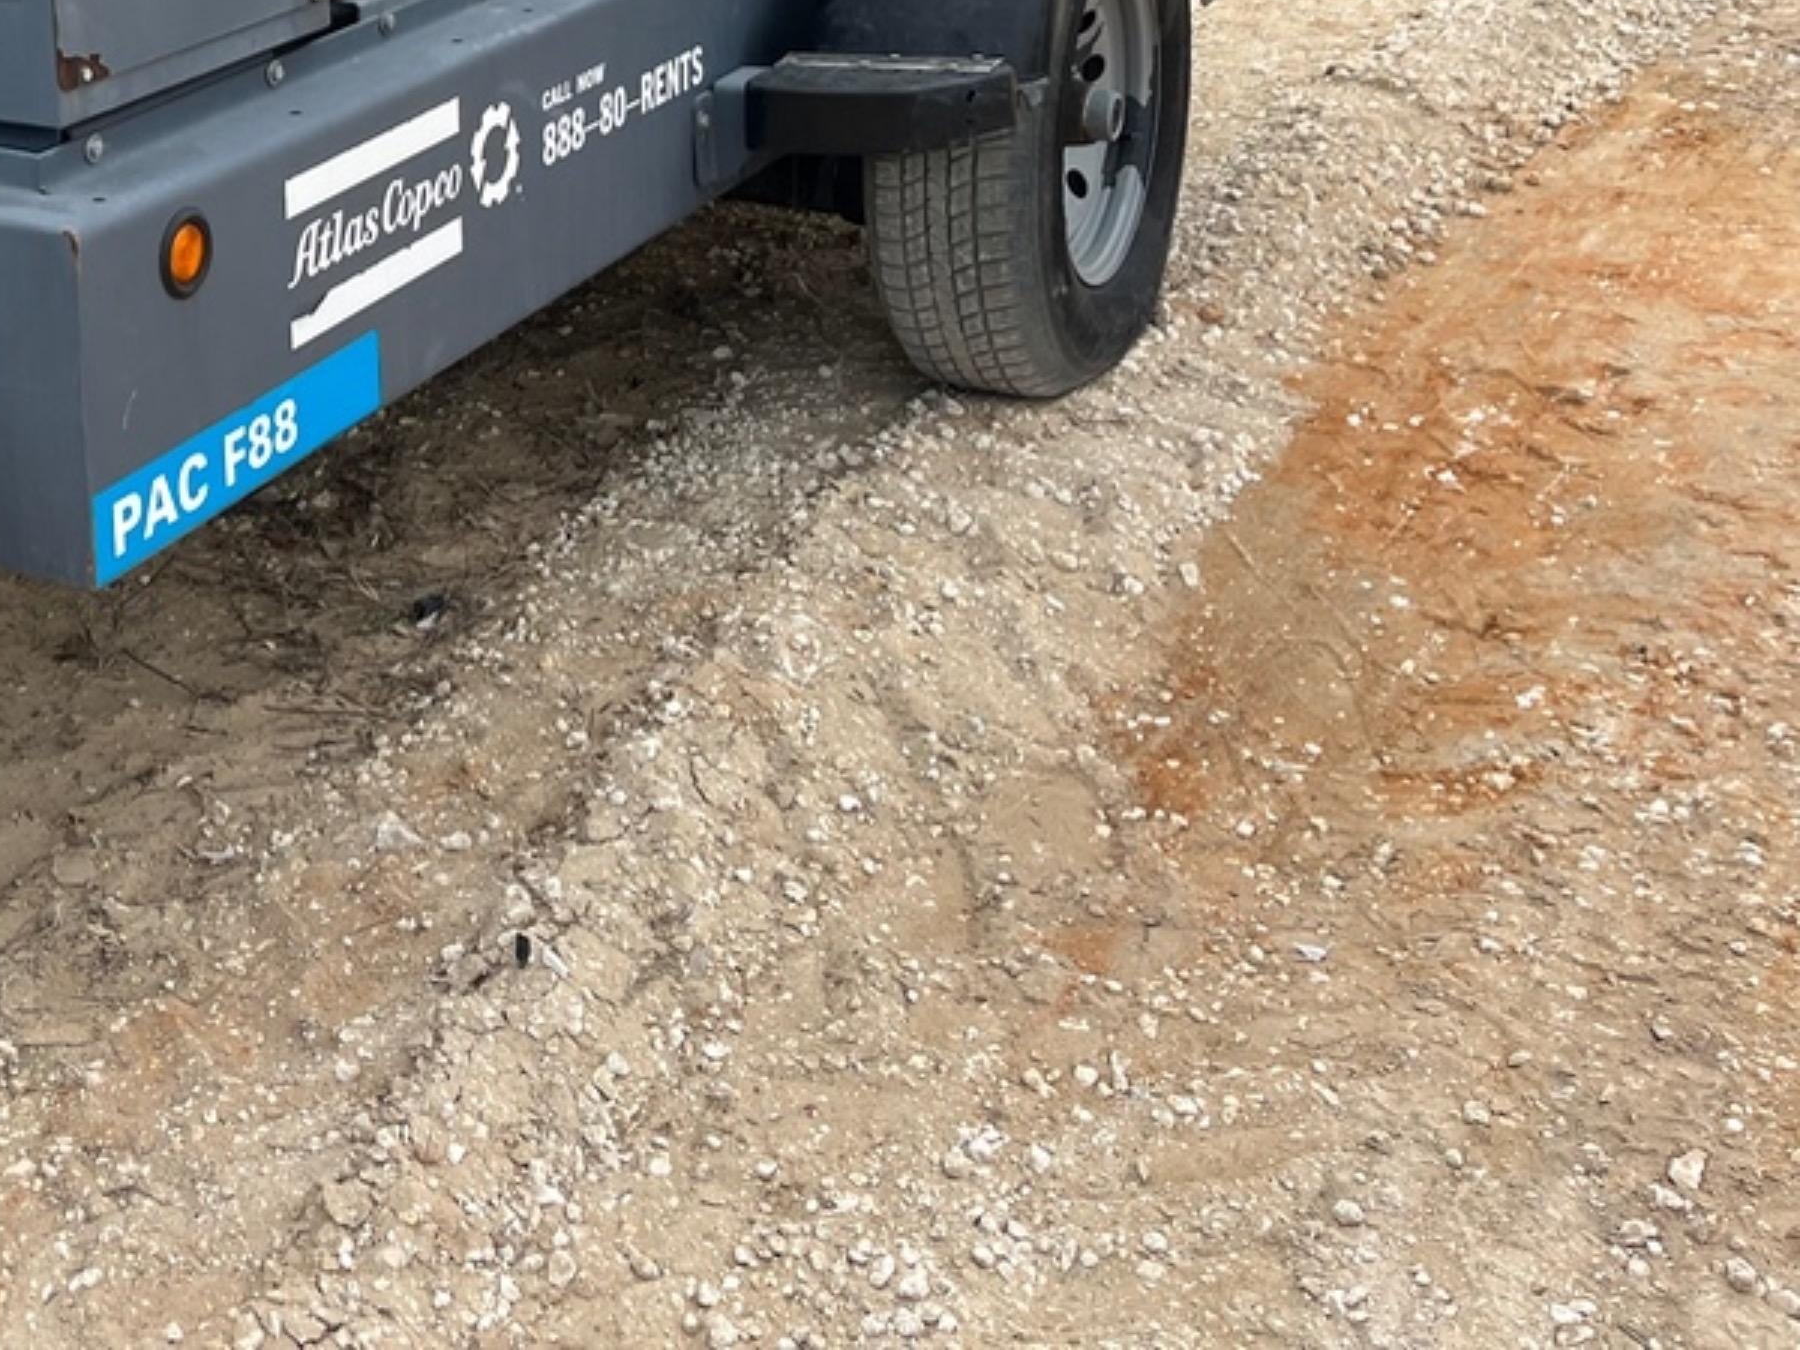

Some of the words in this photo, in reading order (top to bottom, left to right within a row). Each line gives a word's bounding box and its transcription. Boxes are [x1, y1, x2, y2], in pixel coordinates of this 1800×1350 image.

[542, 80, 573, 111] CALL
[575, 62, 606, 94] NOW
[286, 206, 380, 290] Atlas
[382, 162, 464, 232] Copco
[112, 451, 210, 559] PAC
[223, 397, 299, 488] F88
